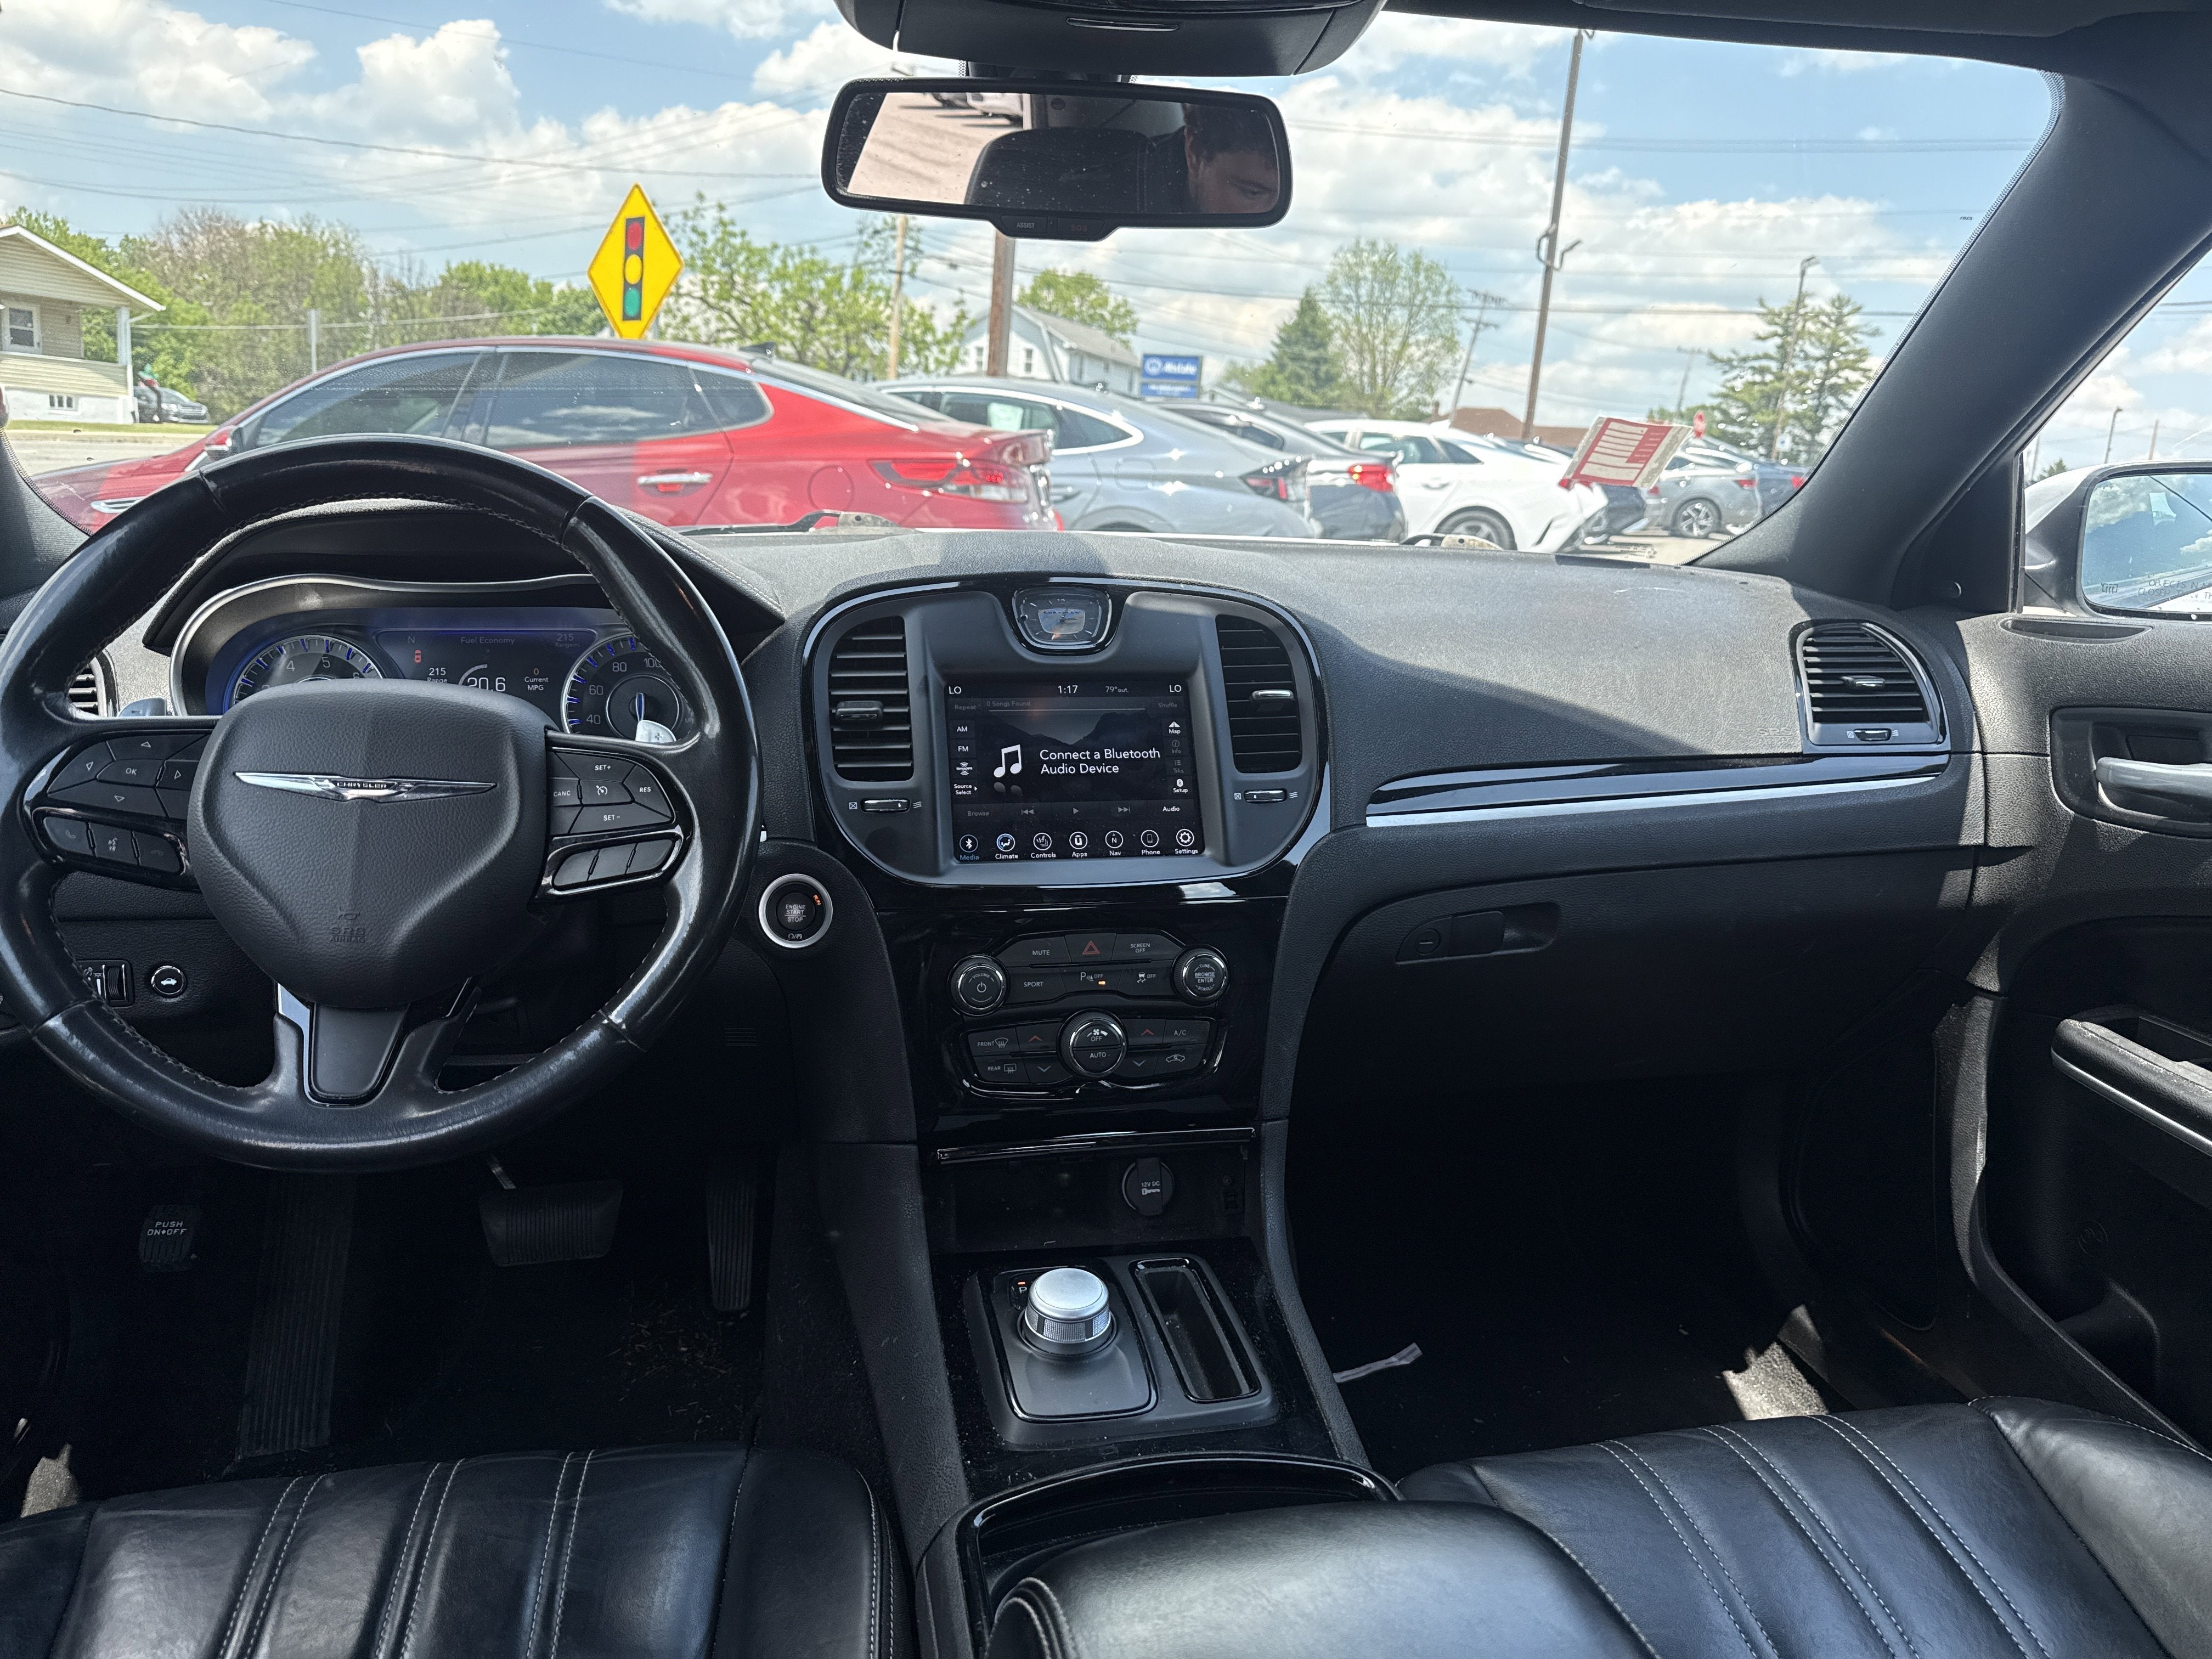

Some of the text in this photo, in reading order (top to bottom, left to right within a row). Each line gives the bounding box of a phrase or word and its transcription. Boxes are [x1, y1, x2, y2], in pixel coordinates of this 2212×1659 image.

[2148, 579, 2186, 589] OBJECTS
[2138, 588, 2171, 597] CLOSER
[479, 636, 516, 645] Economy
[286, 660, 296, 672] 4
[321, 657, 330, 668] 5
[612, 662, 627, 672] 80
[428, 668, 446, 676] 215
[467, 677, 506, 692] 20.6
[1057, 685, 1079, 694] 1:17
[1169, 684, 1182, 692] LO
[589, 685, 603, 695] 60
[949, 686, 962, 695] LO
[586, 714, 601, 725] 40
[1040, 747, 1160, 760] Connect a Bluetooth
[1041, 763, 1119, 775] Audio Device
[330, 927, 365, 935] SRS
[1080, 972, 1086, 981] P
